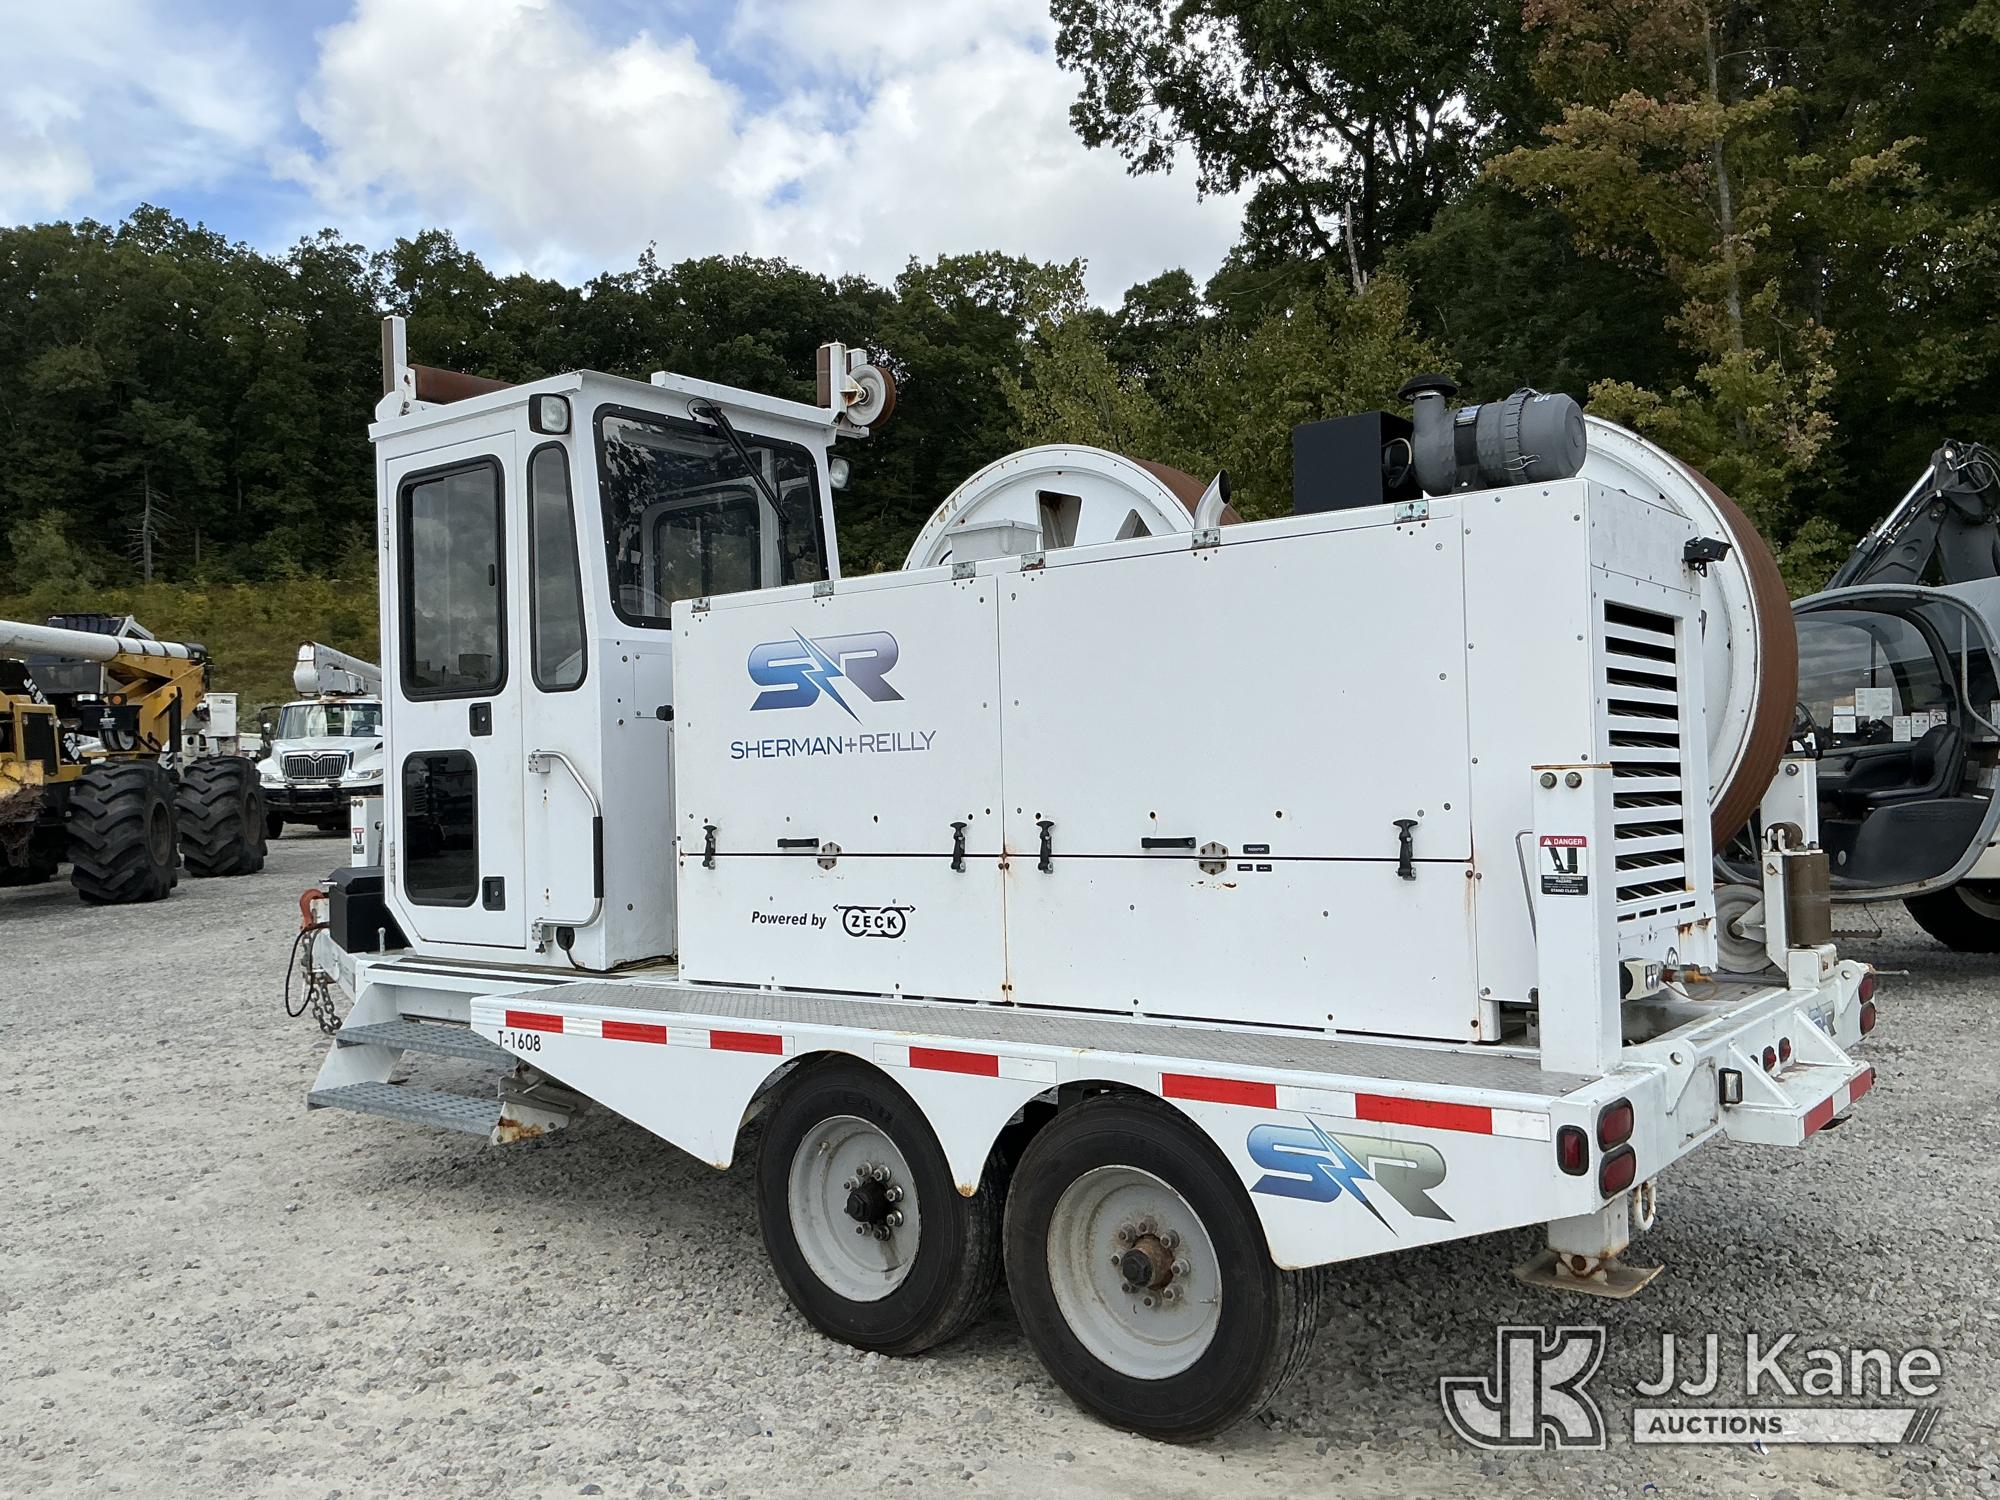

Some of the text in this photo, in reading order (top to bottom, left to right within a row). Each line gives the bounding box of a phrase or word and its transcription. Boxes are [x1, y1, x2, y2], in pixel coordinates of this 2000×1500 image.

[1553, 838, 1583, 846] DANGER
[751, 911, 827, 930] Powered by
[851, 915, 898, 929] ZECK
[498, 1030, 541, 1052] T-1608
